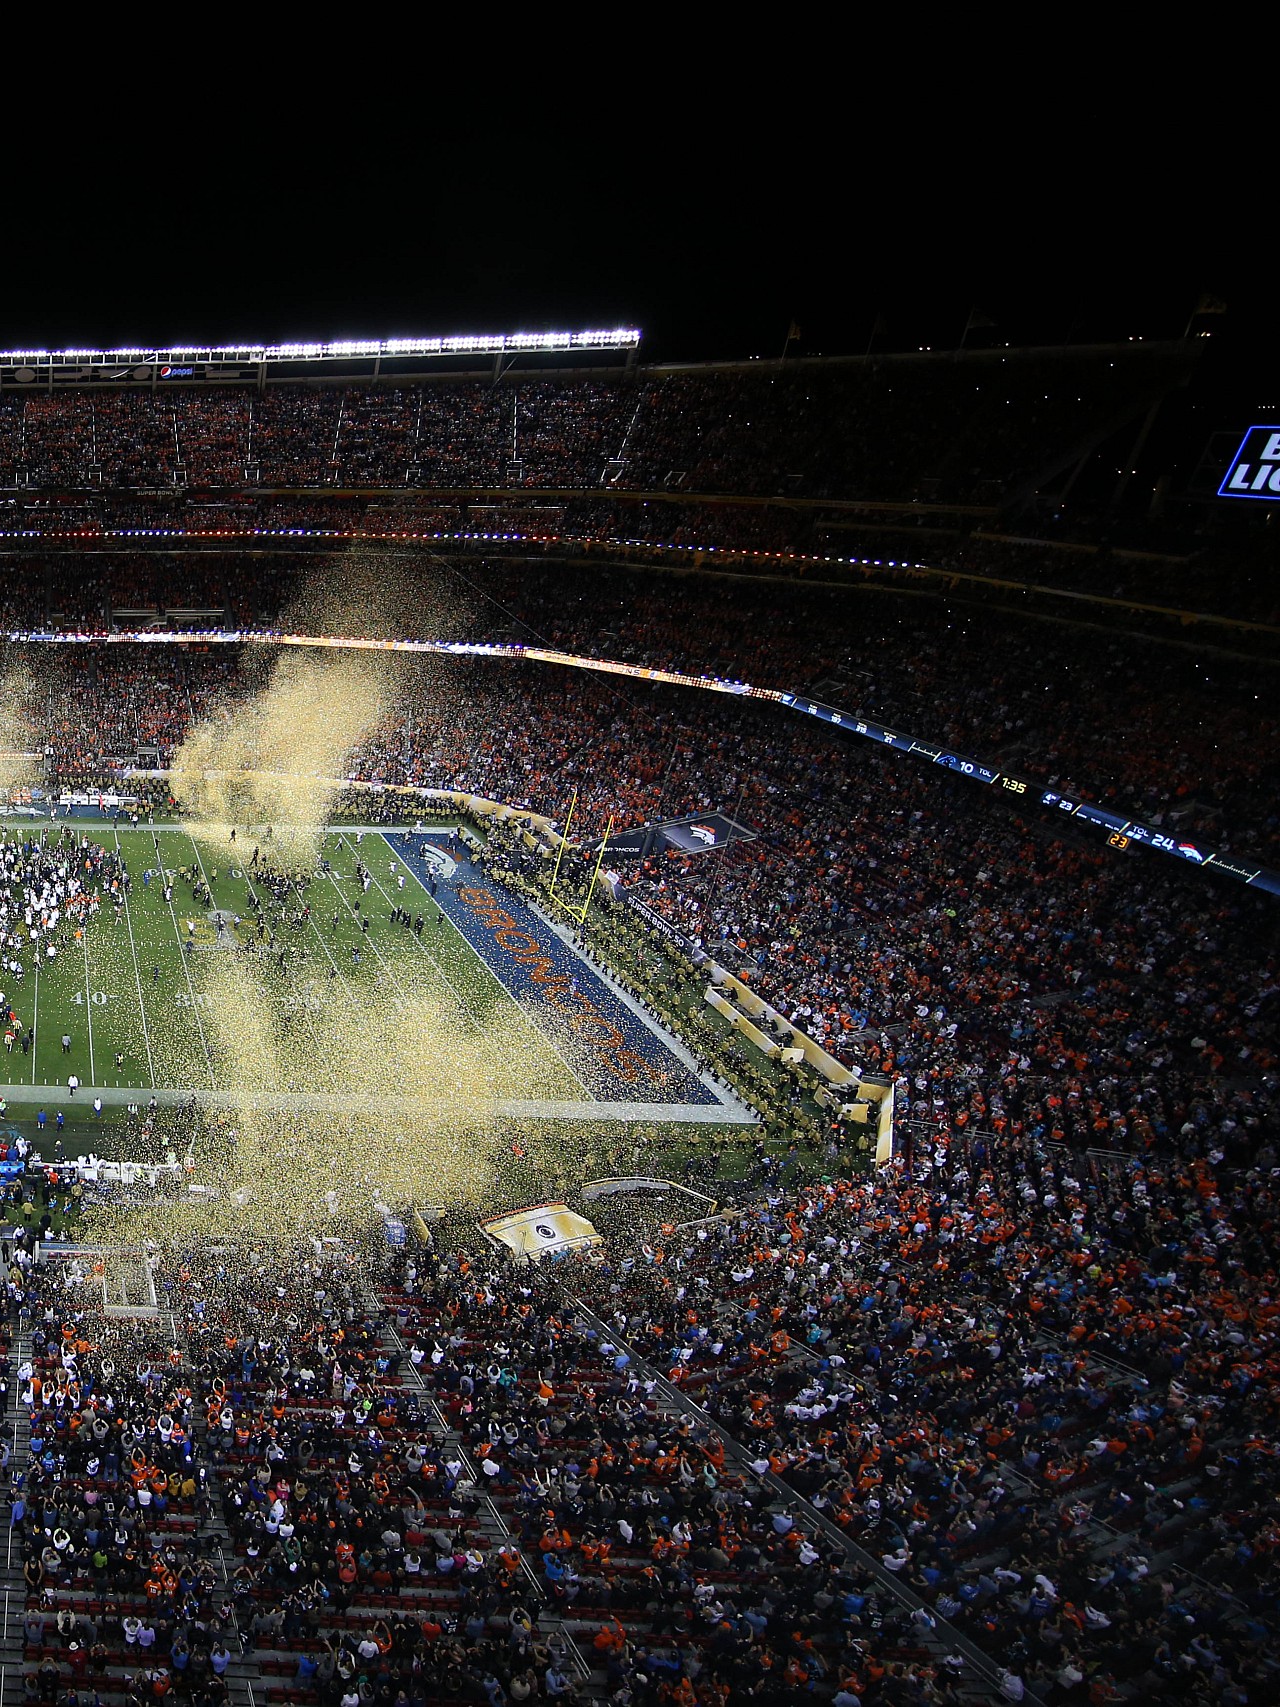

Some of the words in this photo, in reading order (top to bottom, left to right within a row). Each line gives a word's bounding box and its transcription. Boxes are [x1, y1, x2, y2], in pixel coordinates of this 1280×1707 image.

[960, 762, 974, 773] 10
[978, 768, 992, 778] TOL
[1002, 777, 1027, 794] 1:35
[1058, 800, 1073, 811] 23
[1110, 834, 1128, 848] 23
[1133, 826, 1149, 837] TOL
[1151, 834, 1176, 850] 24
[628, 896, 651, 920] SUPER
[651, 916, 673, 939] BOWL
[673, 934, 684, 947] 50
[458, 888, 658, 1082] BRONCOS
[69, 992, 108, 1006] 40
